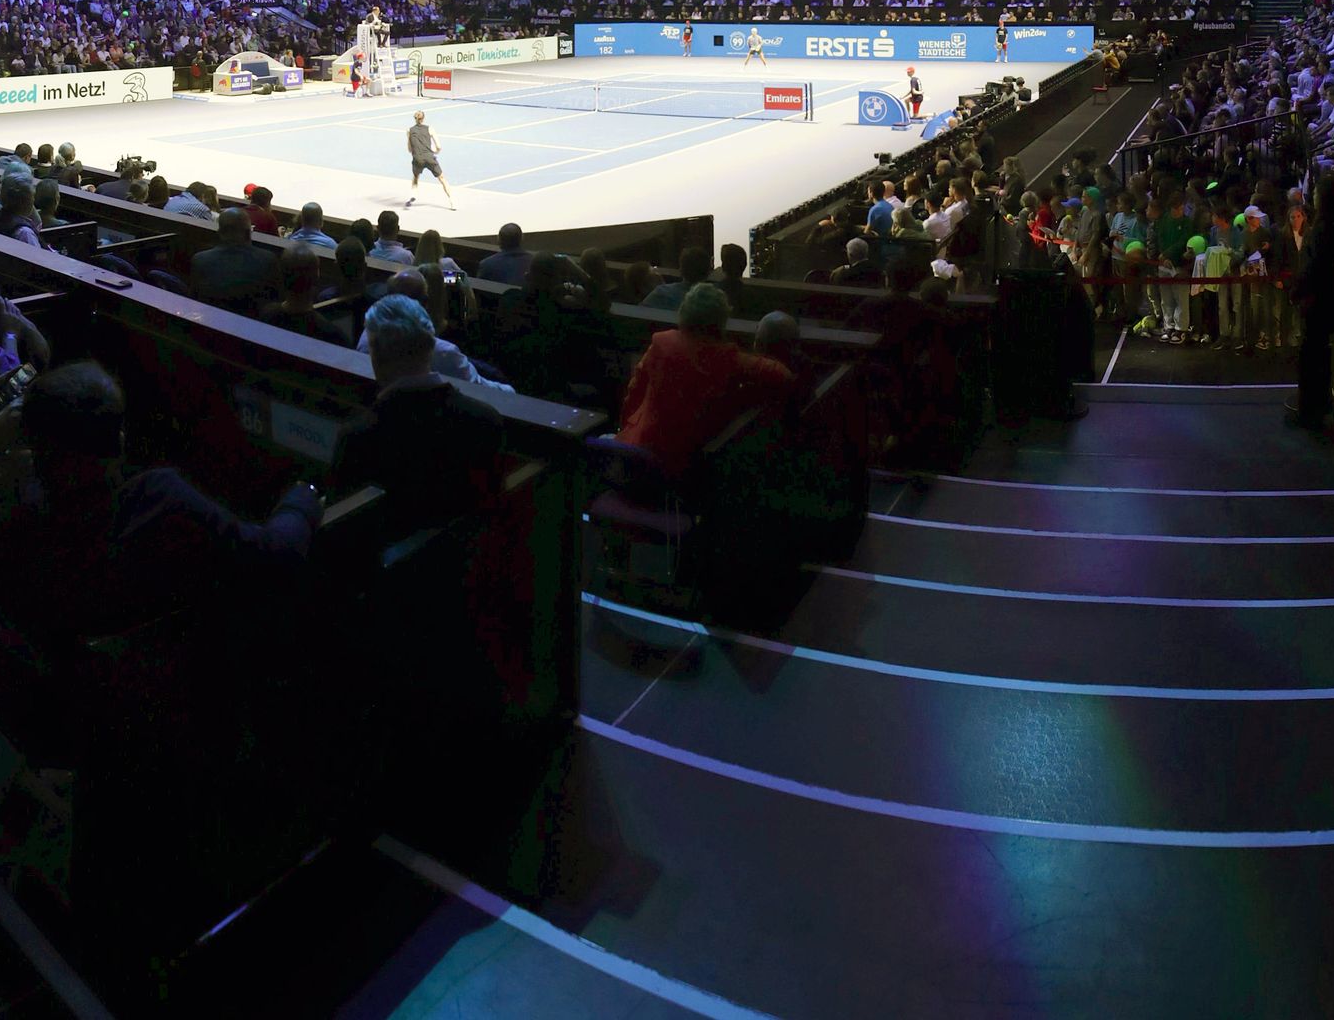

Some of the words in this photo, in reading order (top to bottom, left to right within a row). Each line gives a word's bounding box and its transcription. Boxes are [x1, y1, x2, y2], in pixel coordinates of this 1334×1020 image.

[806, 37, 869, 57] ERSTE
[918, 40, 951, 49] WIENER
[599, 46, 613, 55] 182
[436, 53, 455, 65] Drei.
[457, 51, 475, 62] Dein
[425, 75, 451, 85] Emirates
[43, 85, 62, 101] im
[67, 81, 106, 99] Netz!
[765, 94, 802, 104] Emirates
